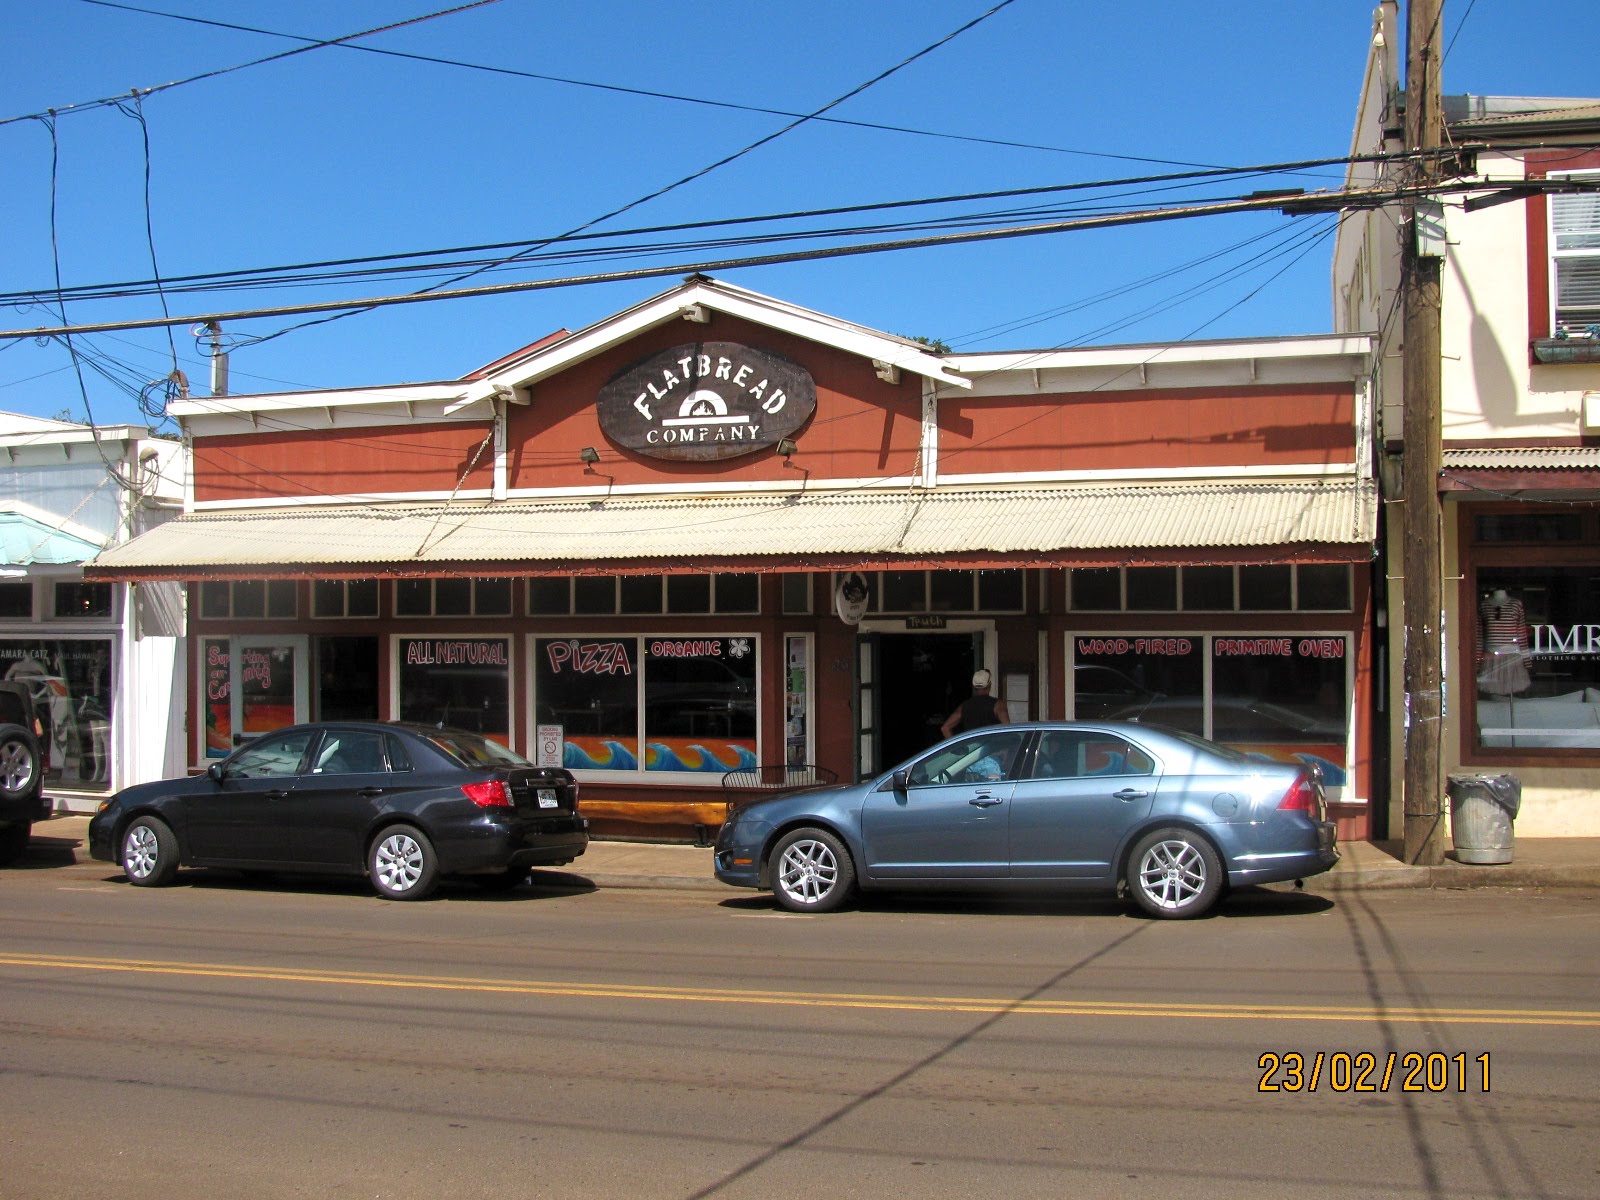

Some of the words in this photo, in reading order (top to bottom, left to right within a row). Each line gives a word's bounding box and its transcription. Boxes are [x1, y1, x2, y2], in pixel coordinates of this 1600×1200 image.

[633, 354, 787, 421] FLATBREAD
[646, 425, 761, 444] COMPANY
[0, 649, 27, 659] AMARA
[30, 649, 49, 659] CATZ
[407, 641, 435, 665] ALL
[435, 641, 508, 665] NATURAL
[651, 641, 722, 657] ORGANIC
[1215, 639, 1292, 656] PRIMITIVE
[1298, 638, 1344, 658] OVEN
